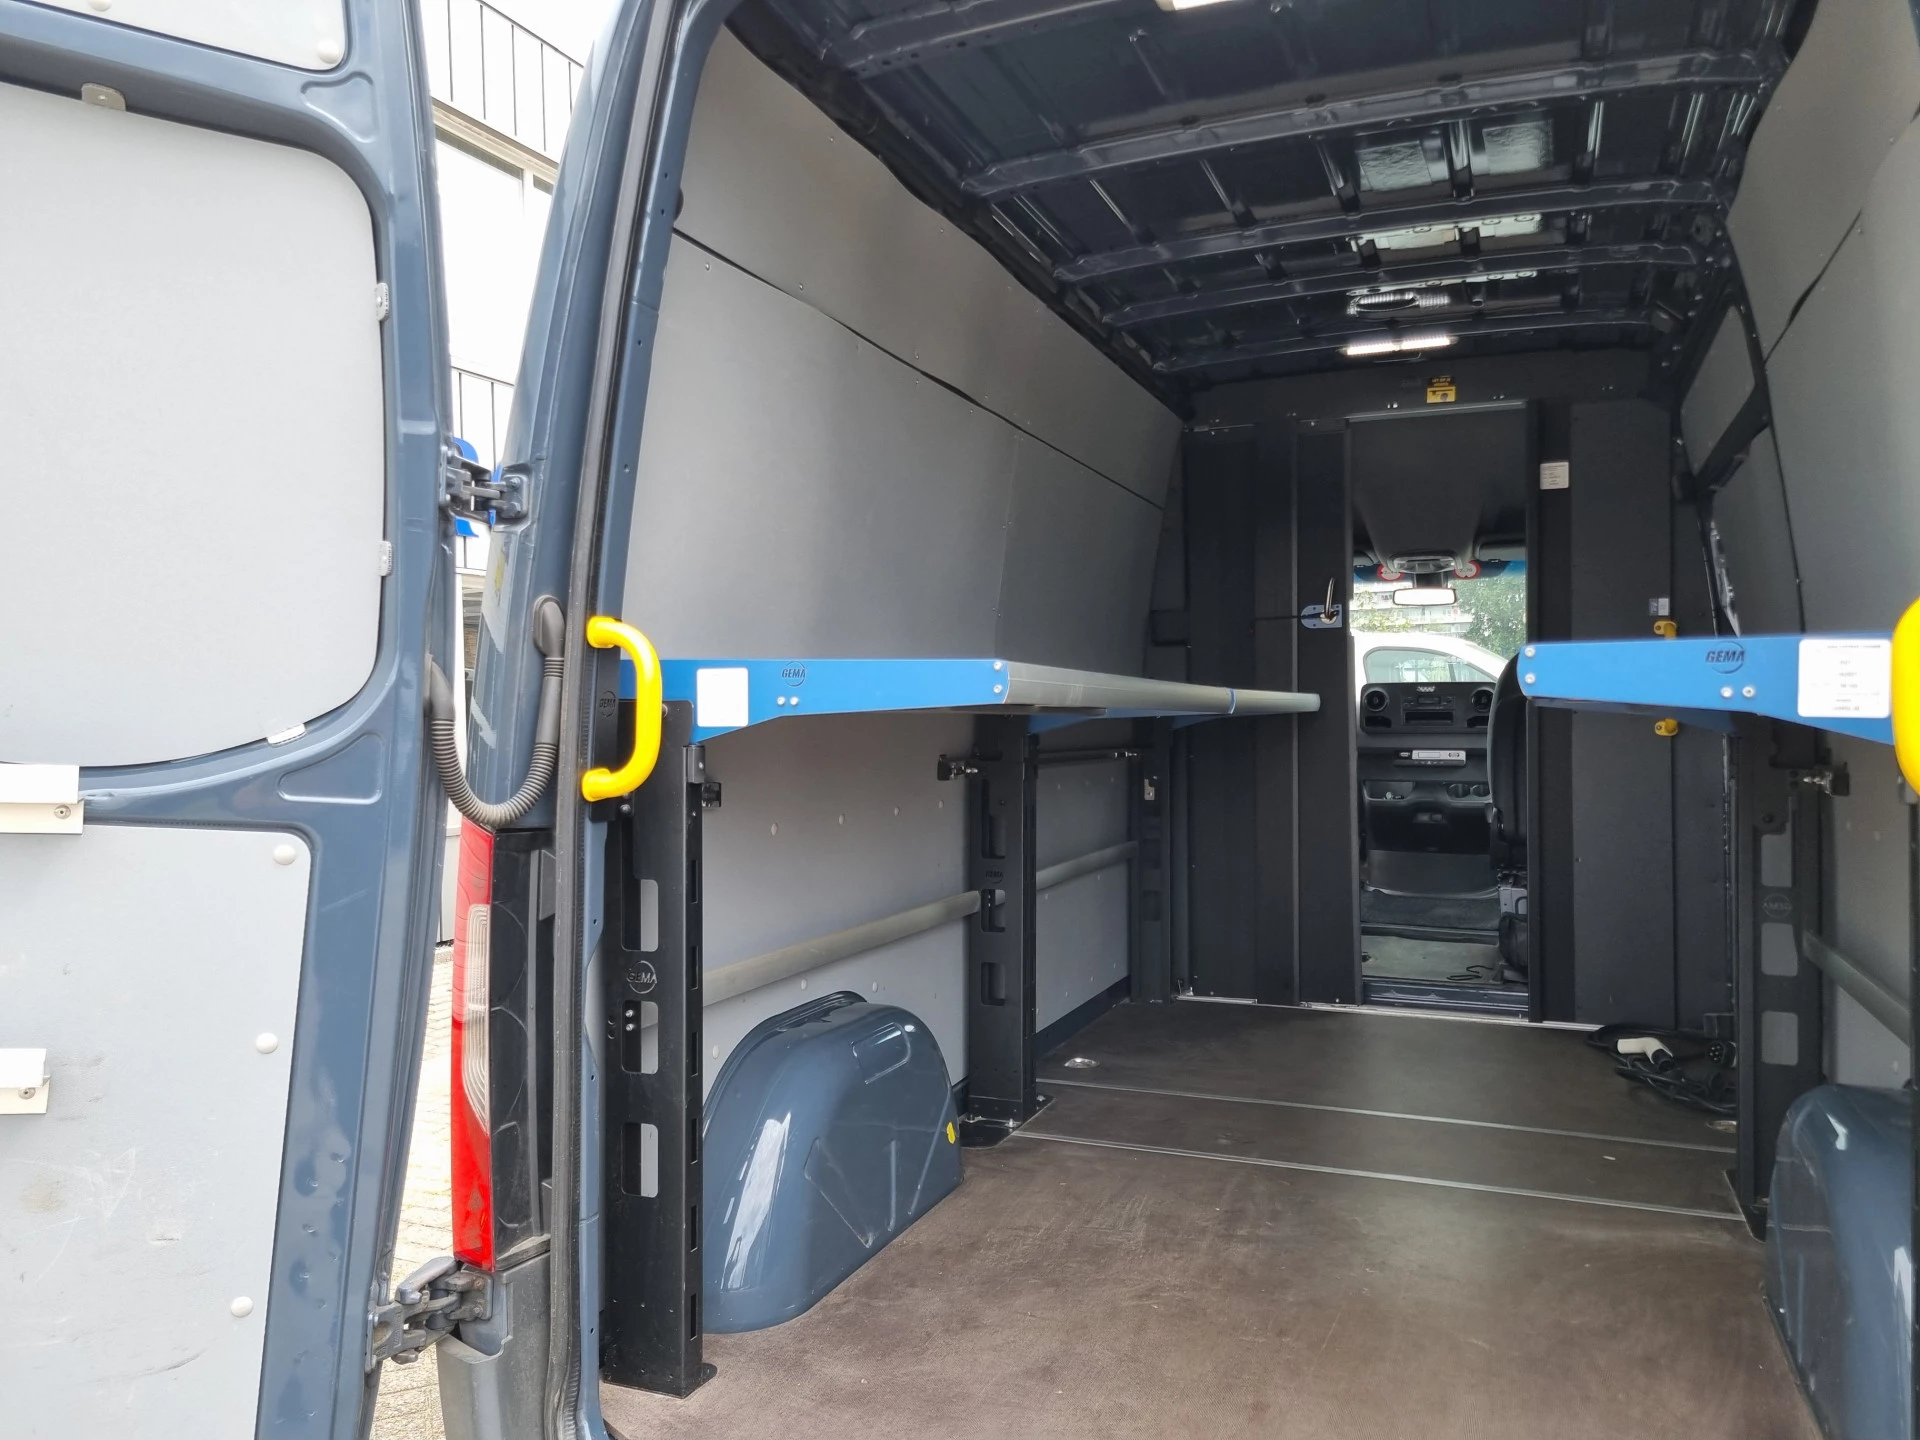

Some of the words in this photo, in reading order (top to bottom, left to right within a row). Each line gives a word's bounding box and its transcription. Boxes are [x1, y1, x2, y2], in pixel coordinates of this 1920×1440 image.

[1705, 650, 1745, 663] GEMA
[781, 668, 806, 679] GEMA
[627, 972, 658, 983] GEMA
